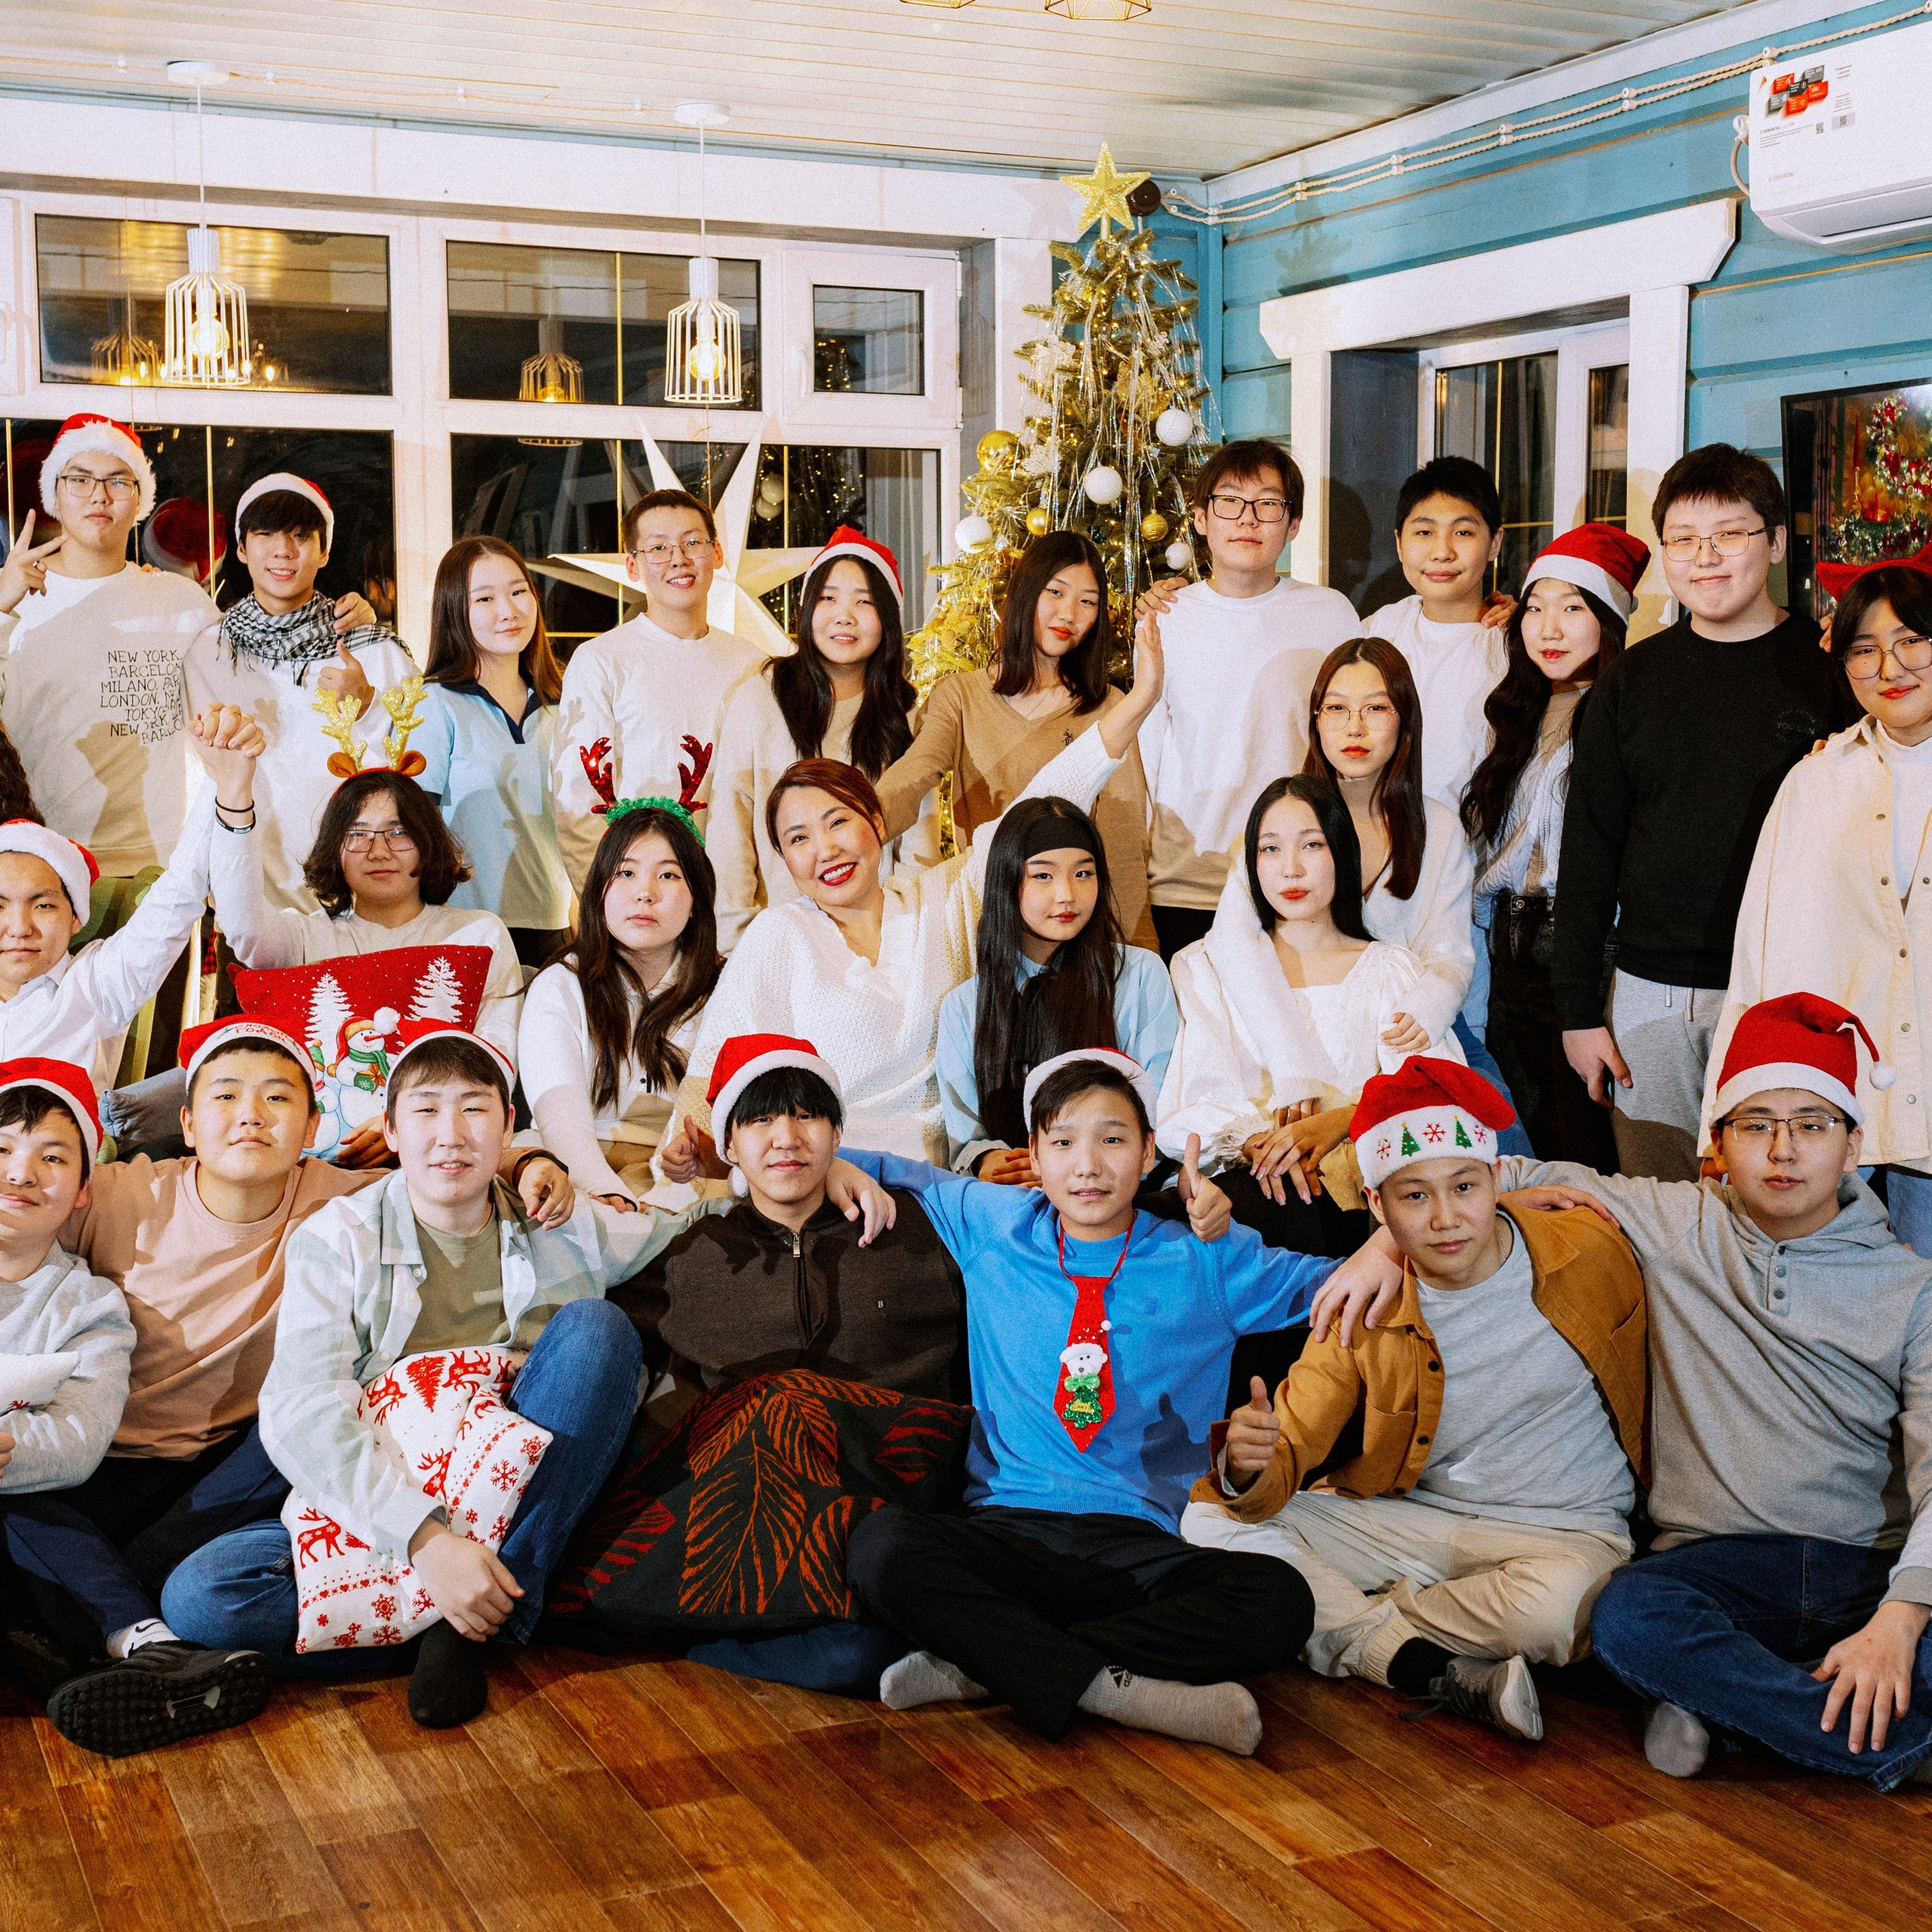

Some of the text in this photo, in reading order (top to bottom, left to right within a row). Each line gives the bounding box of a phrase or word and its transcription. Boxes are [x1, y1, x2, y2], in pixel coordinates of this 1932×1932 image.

[108, 651, 137, 663] NEW
[100, 678, 158, 693] MILANO.
[100, 692, 160, 708] LONDON.
[109, 723, 140, 737] NEW
[1777, 722, 1795, 731] YOU
